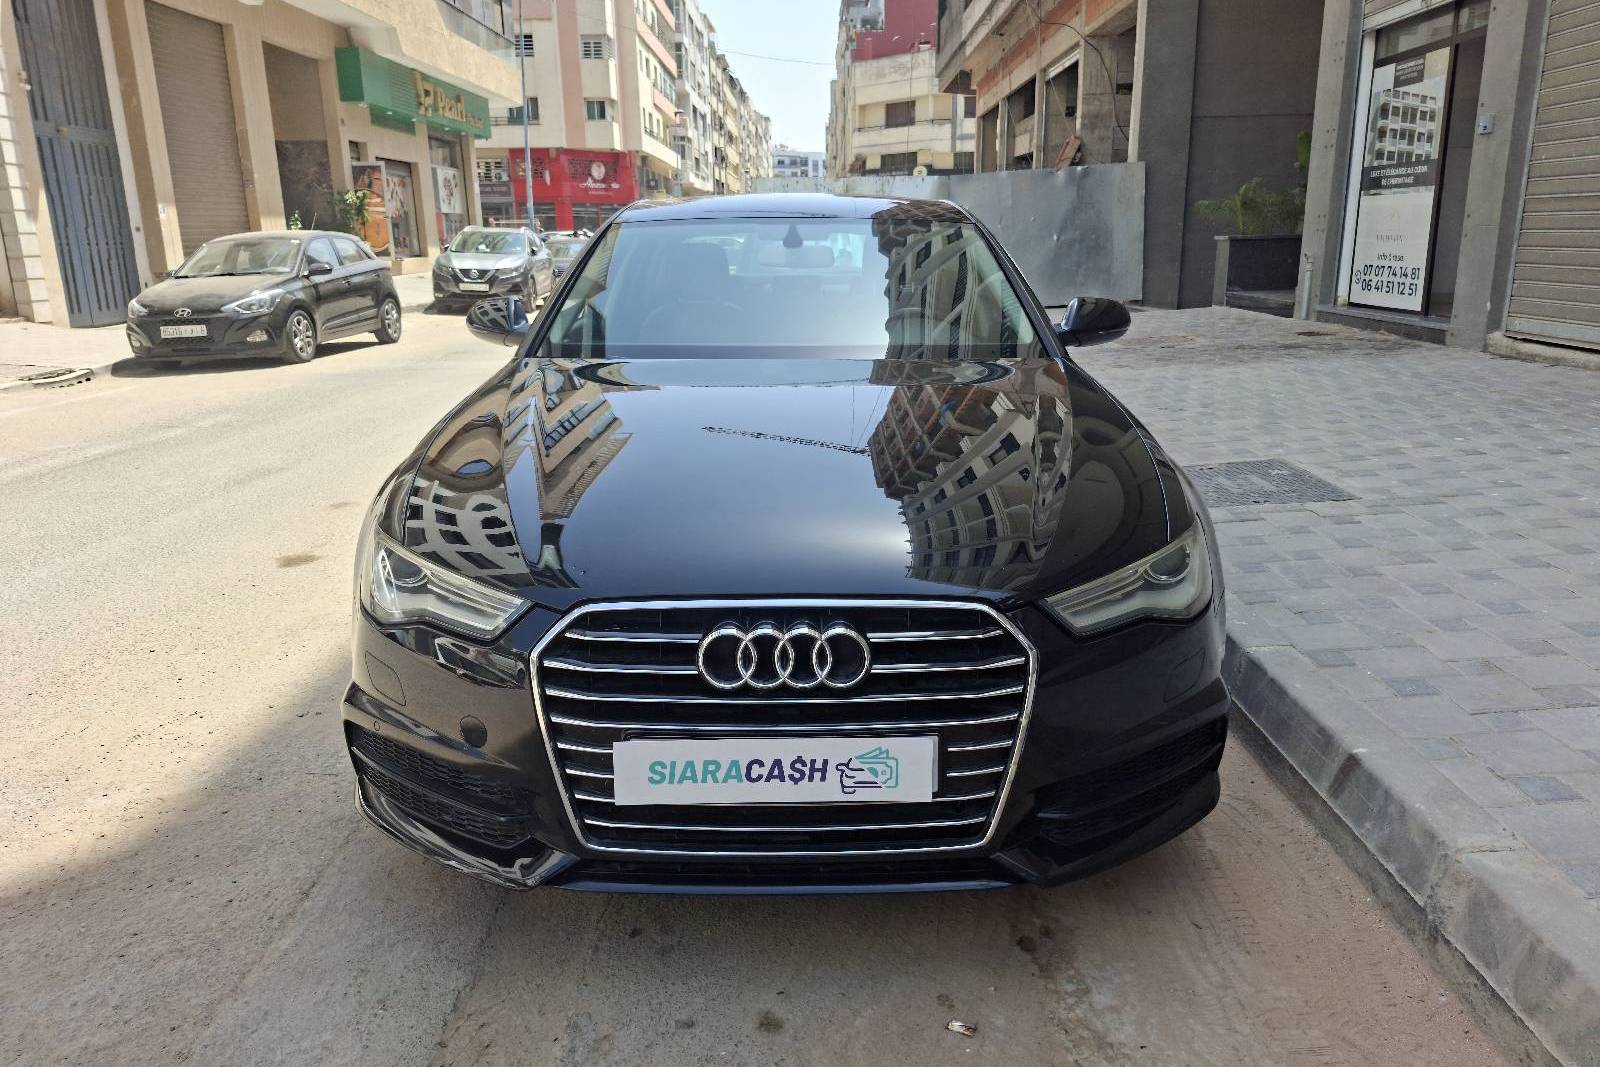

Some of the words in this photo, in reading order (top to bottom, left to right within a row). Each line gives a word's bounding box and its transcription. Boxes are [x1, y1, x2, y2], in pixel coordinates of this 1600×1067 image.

[1363, 264, 1373, 277] 07
[1374, 265, 1385, 277] 07
[1386, 265, 1397, 278] 74
[1399, 266, 1408, 279] 14
[1410, 267, 1420, 280] 81
[1361, 279, 1372, 292] 06
[1374, 280, 1384, 293] 41
[1385, 280, 1395, 294] 51
[1397, 281, 1406, 295] 12
[1407, 282, 1418, 297] 51
[647, 755, 829, 786] SIARACA$H
